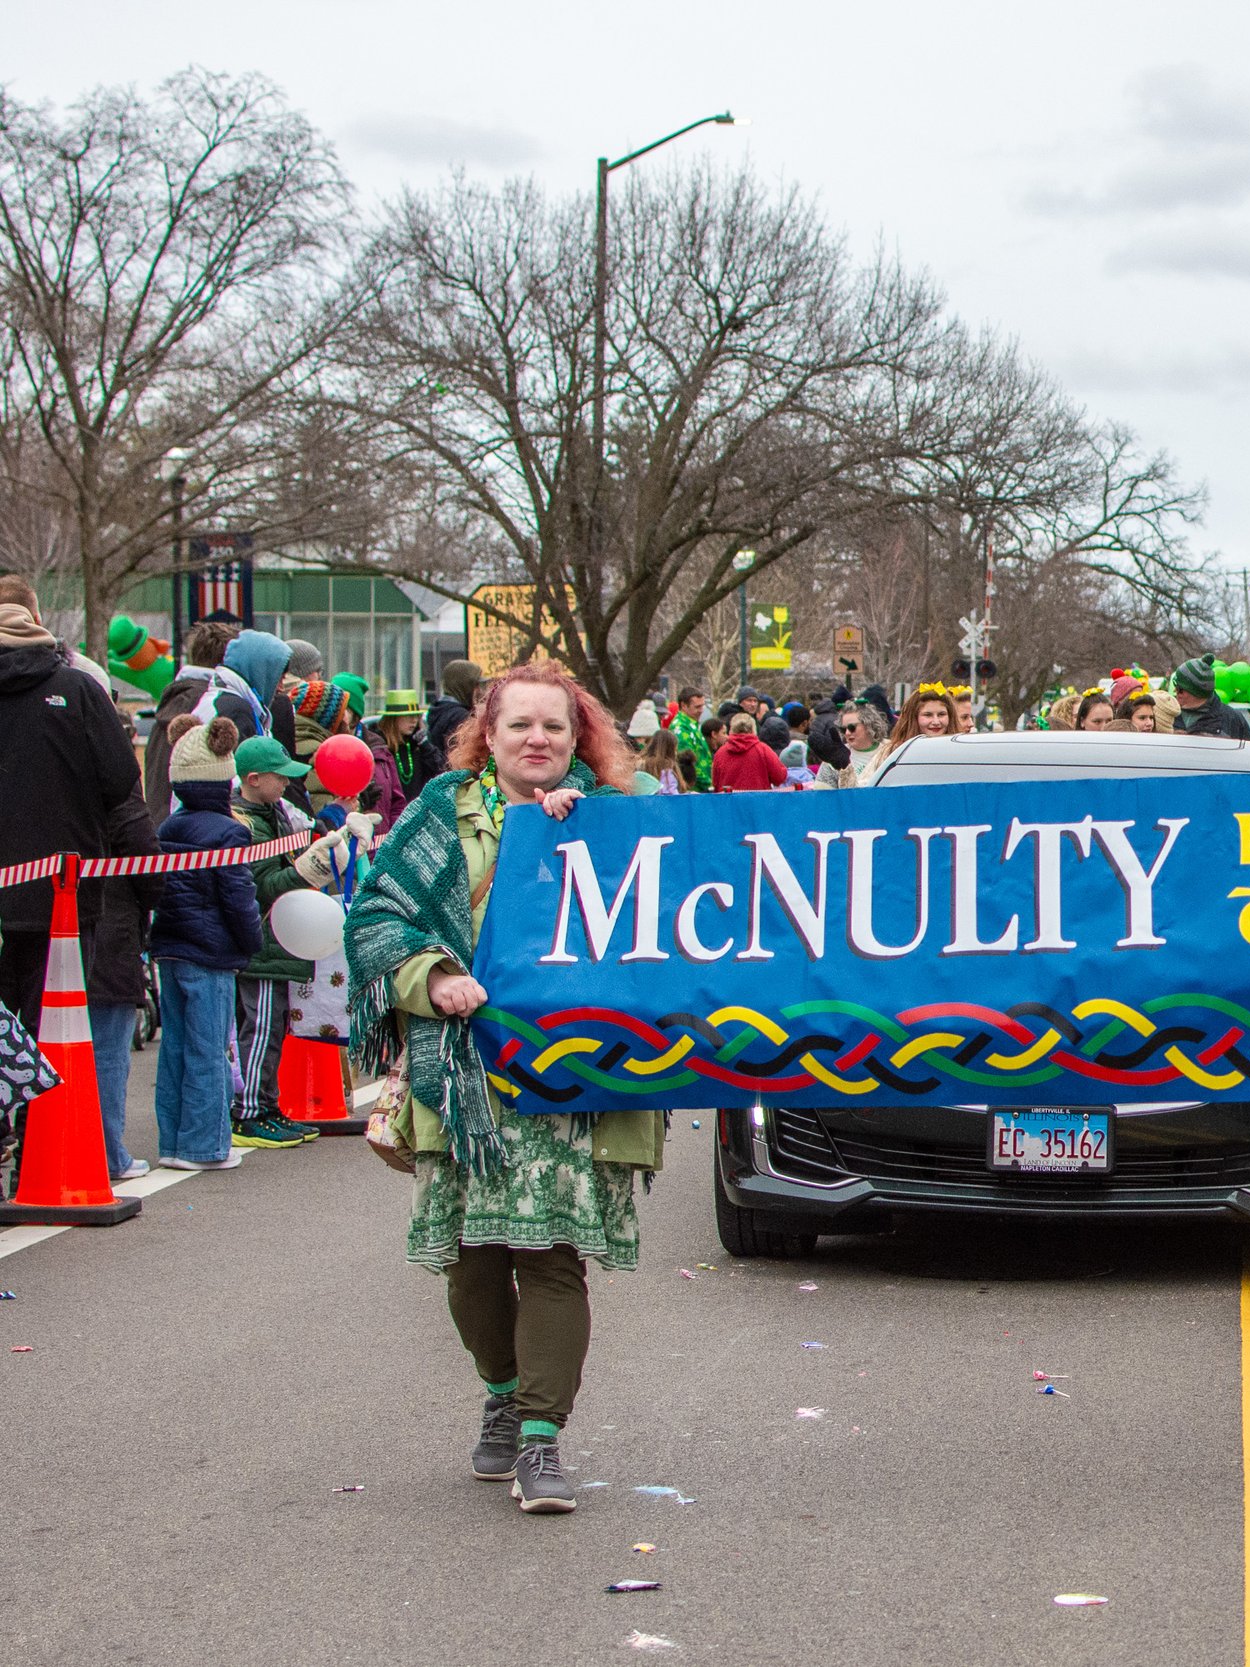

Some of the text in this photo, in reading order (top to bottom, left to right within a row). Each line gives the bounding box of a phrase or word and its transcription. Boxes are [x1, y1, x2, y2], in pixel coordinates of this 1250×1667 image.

[537, 814, 1190, 966] McNULTY
[1023, 1113, 1081, 1121] ILLINOIS
[998, 1128, 1105, 1160] EC 35162
